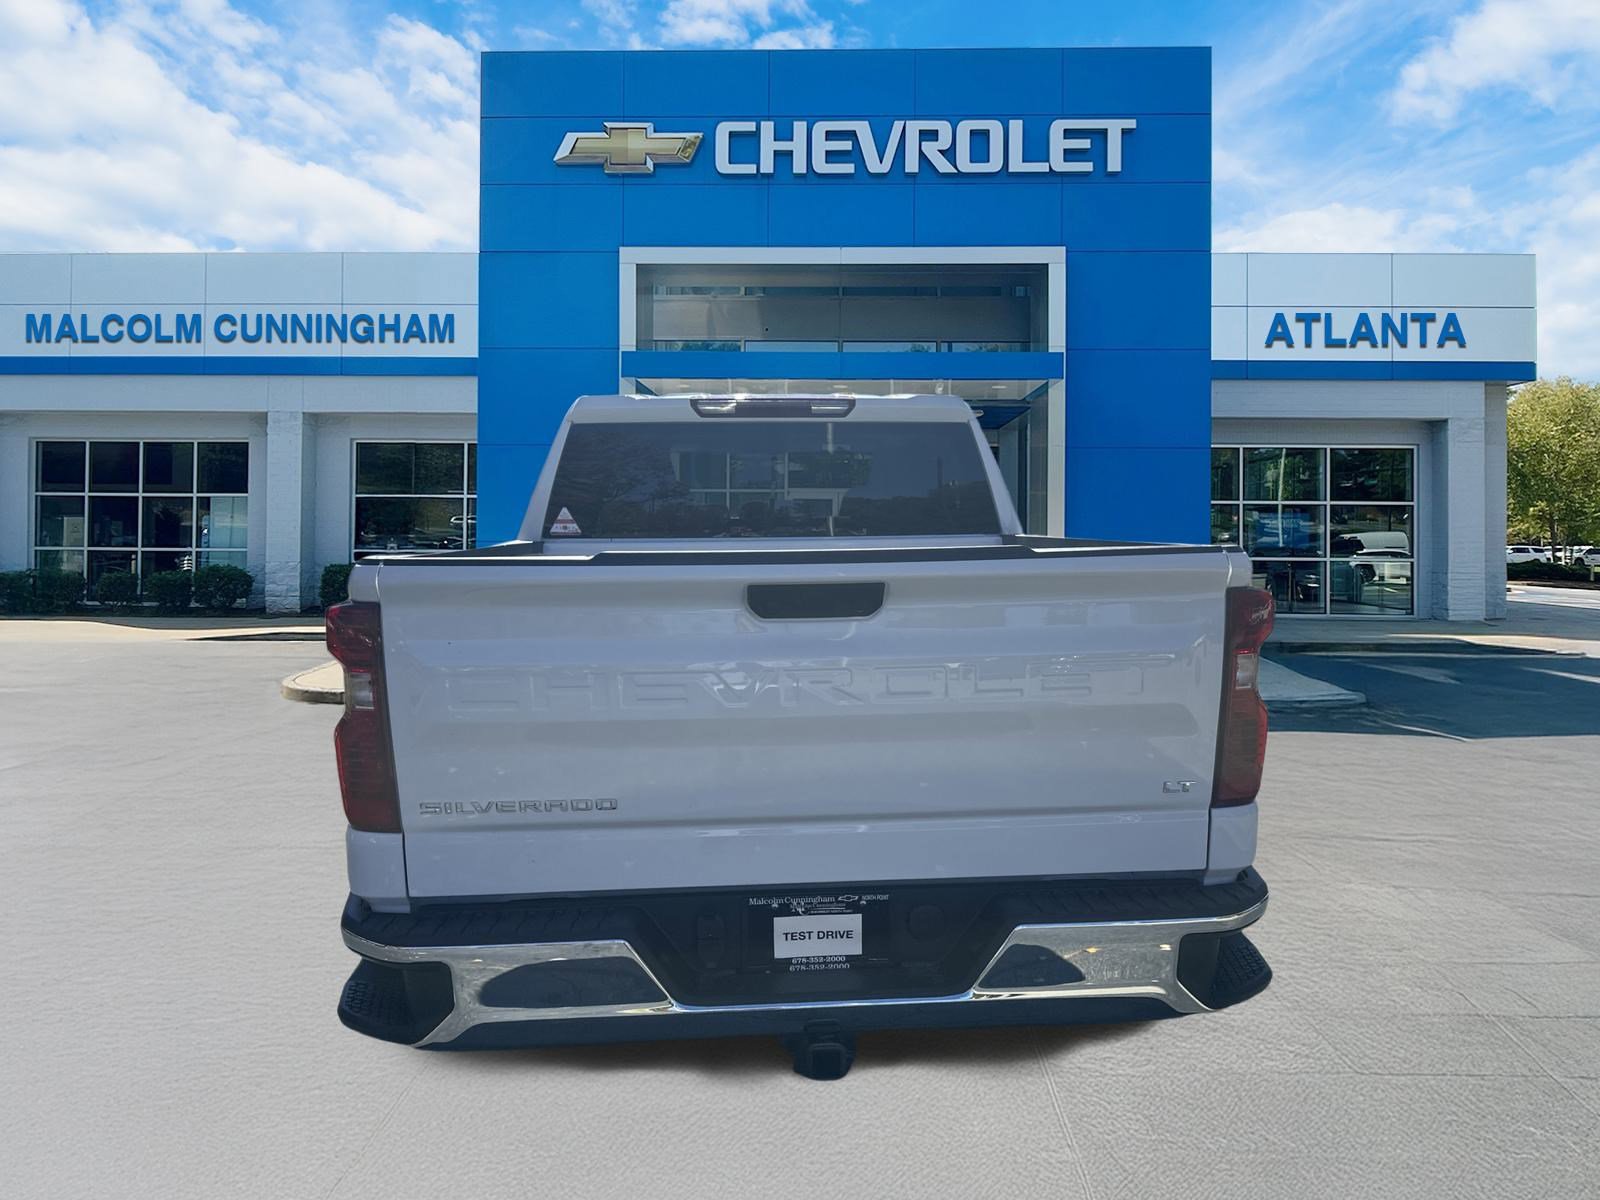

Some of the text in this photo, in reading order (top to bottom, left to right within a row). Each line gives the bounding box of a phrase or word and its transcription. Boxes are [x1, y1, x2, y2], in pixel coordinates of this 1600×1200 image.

[714, 119, 1137, 176] CHEVROLET
[25, 313, 455, 343] MALCOLM CUNNINGHAM
[1264, 312, 1467, 348] ATLANTA
[446, 655, 1175, 710] CHEVROLET
[1162, 780, 1197, 793] LT
[419, 798, 618, 815] SILVERADO
[749, 897, 784, 906] Malcolm
[784, 895, 835, 904] Cunningham
[783, 930, 854, 941] TEST DRIVE
[791, 956, 846, 964] 678-352-2000
